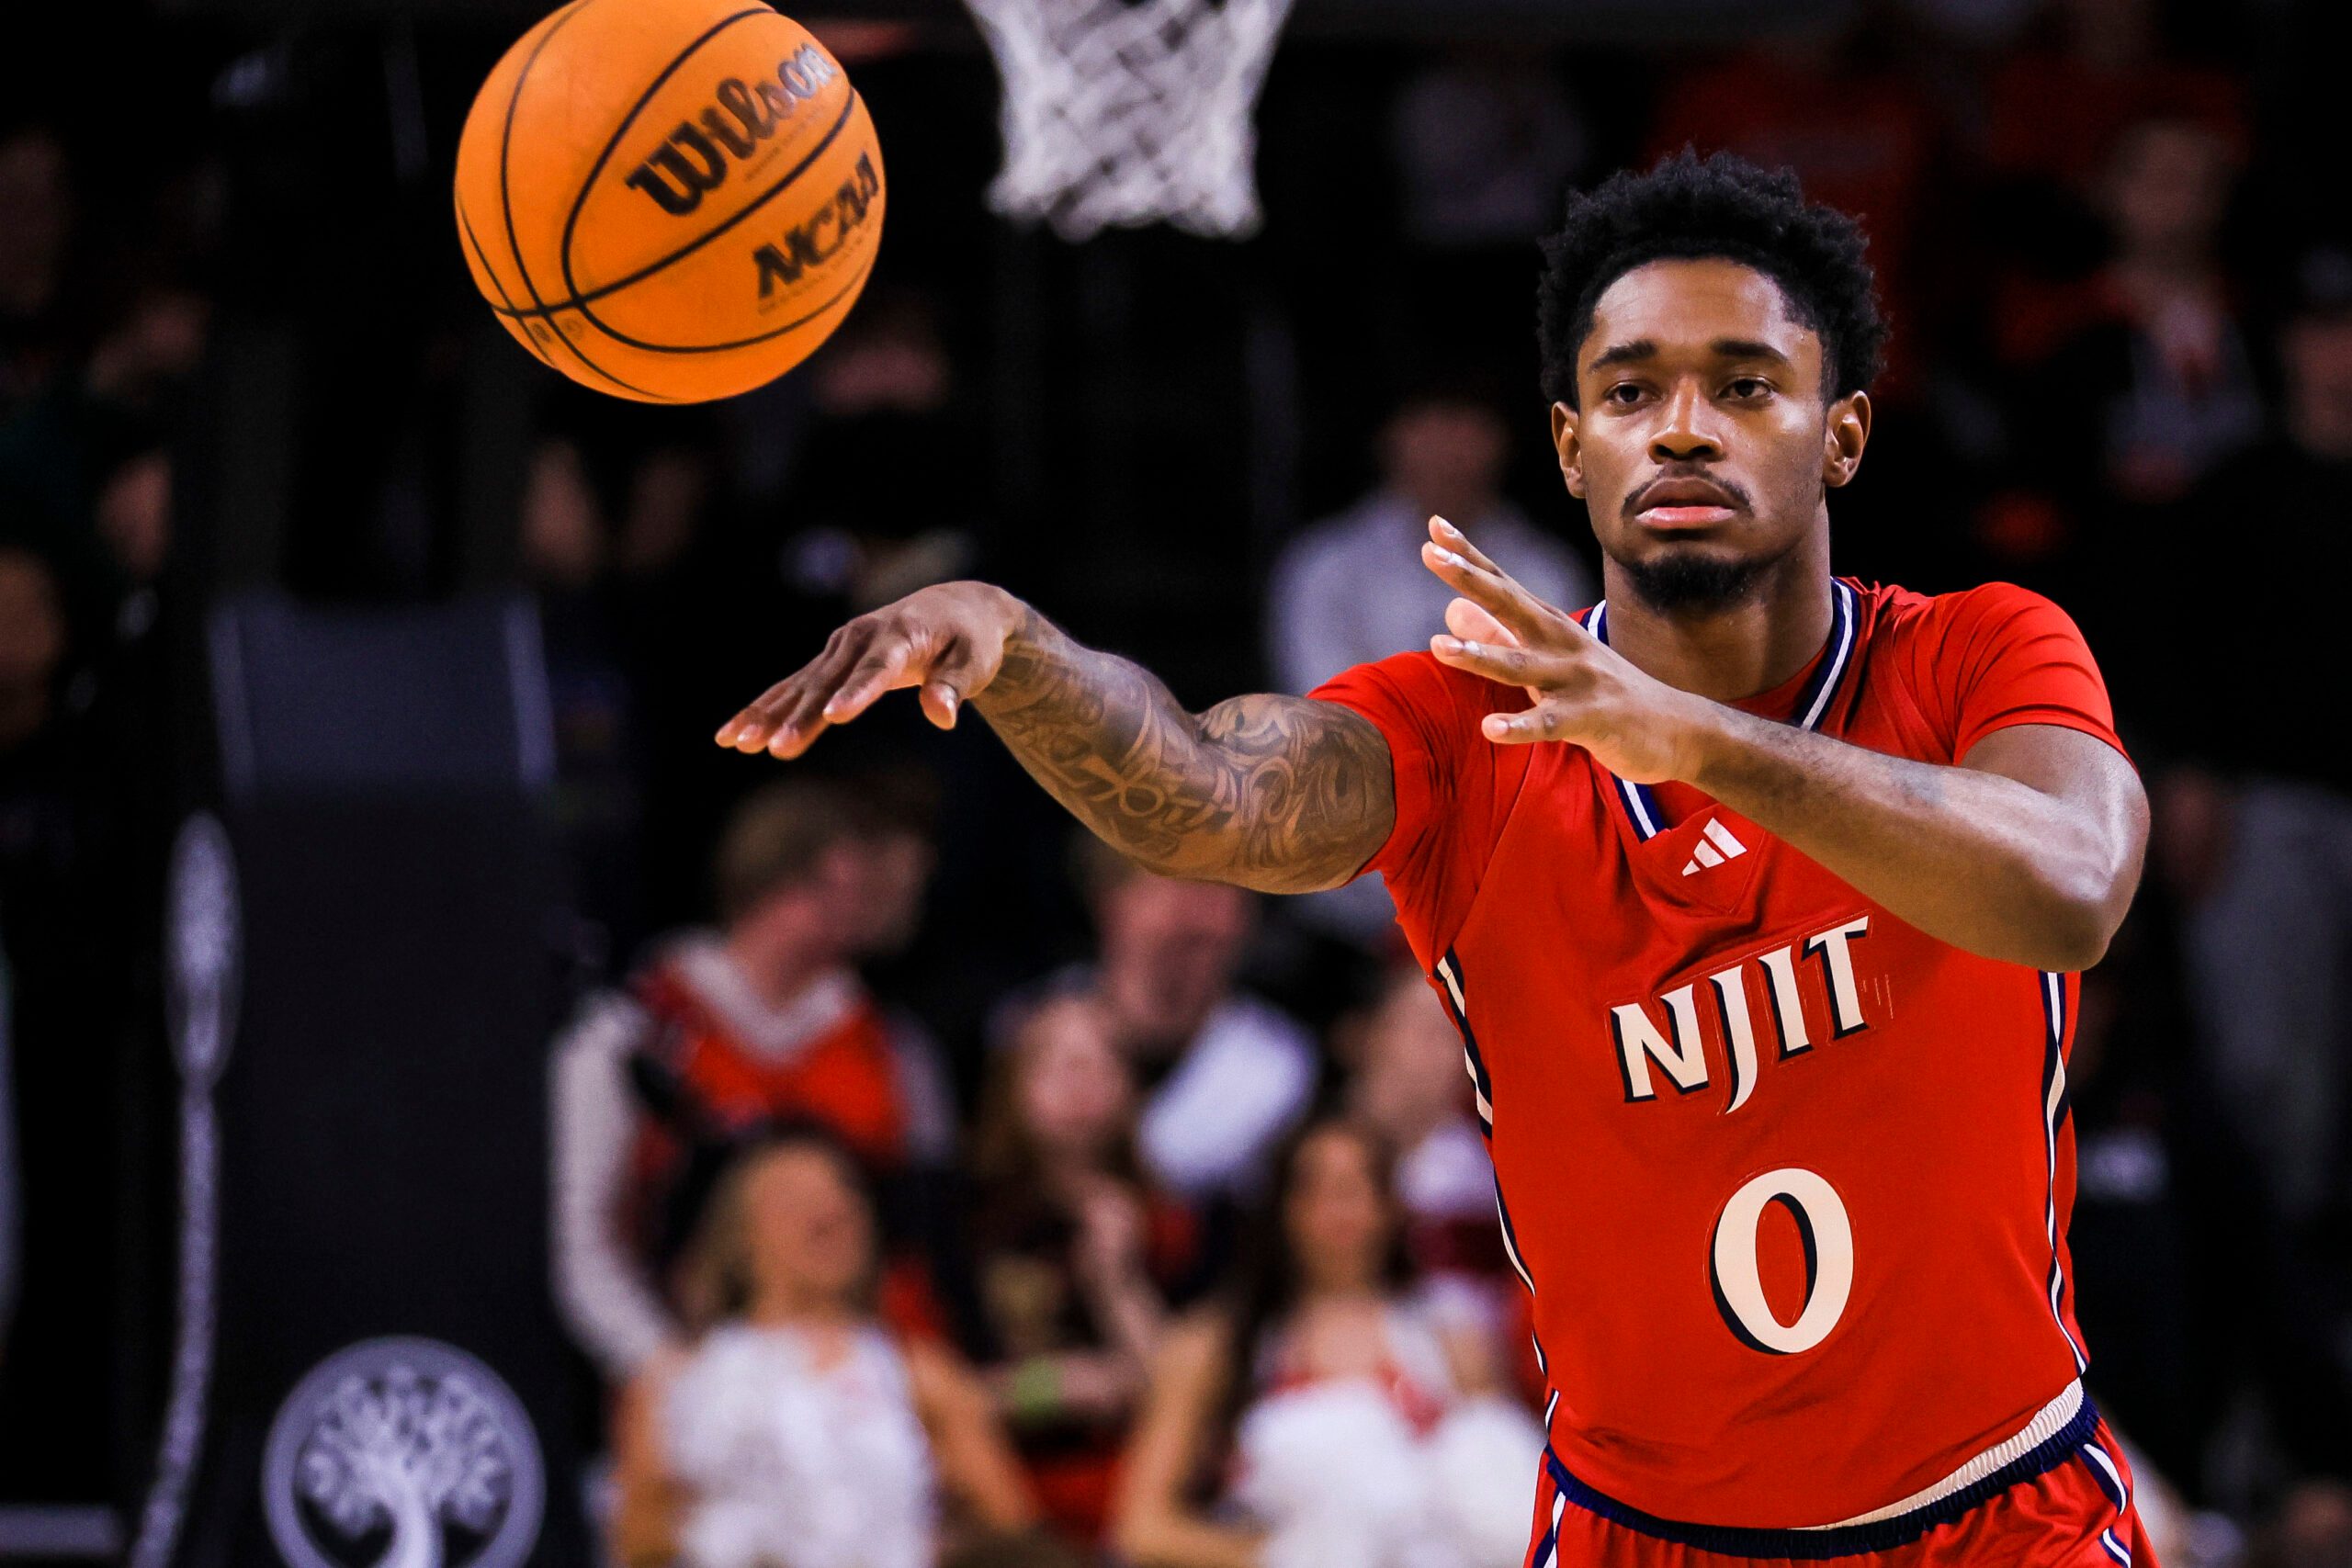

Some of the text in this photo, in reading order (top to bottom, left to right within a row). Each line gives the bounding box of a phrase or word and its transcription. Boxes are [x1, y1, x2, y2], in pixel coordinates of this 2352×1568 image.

[625, 42, 838, 216] Wilson
[752, 150, 879, 299] NCAA
[1610, 915, 1871, 1115] NJIT
[1709, 1167, 1855, 1356] 0
